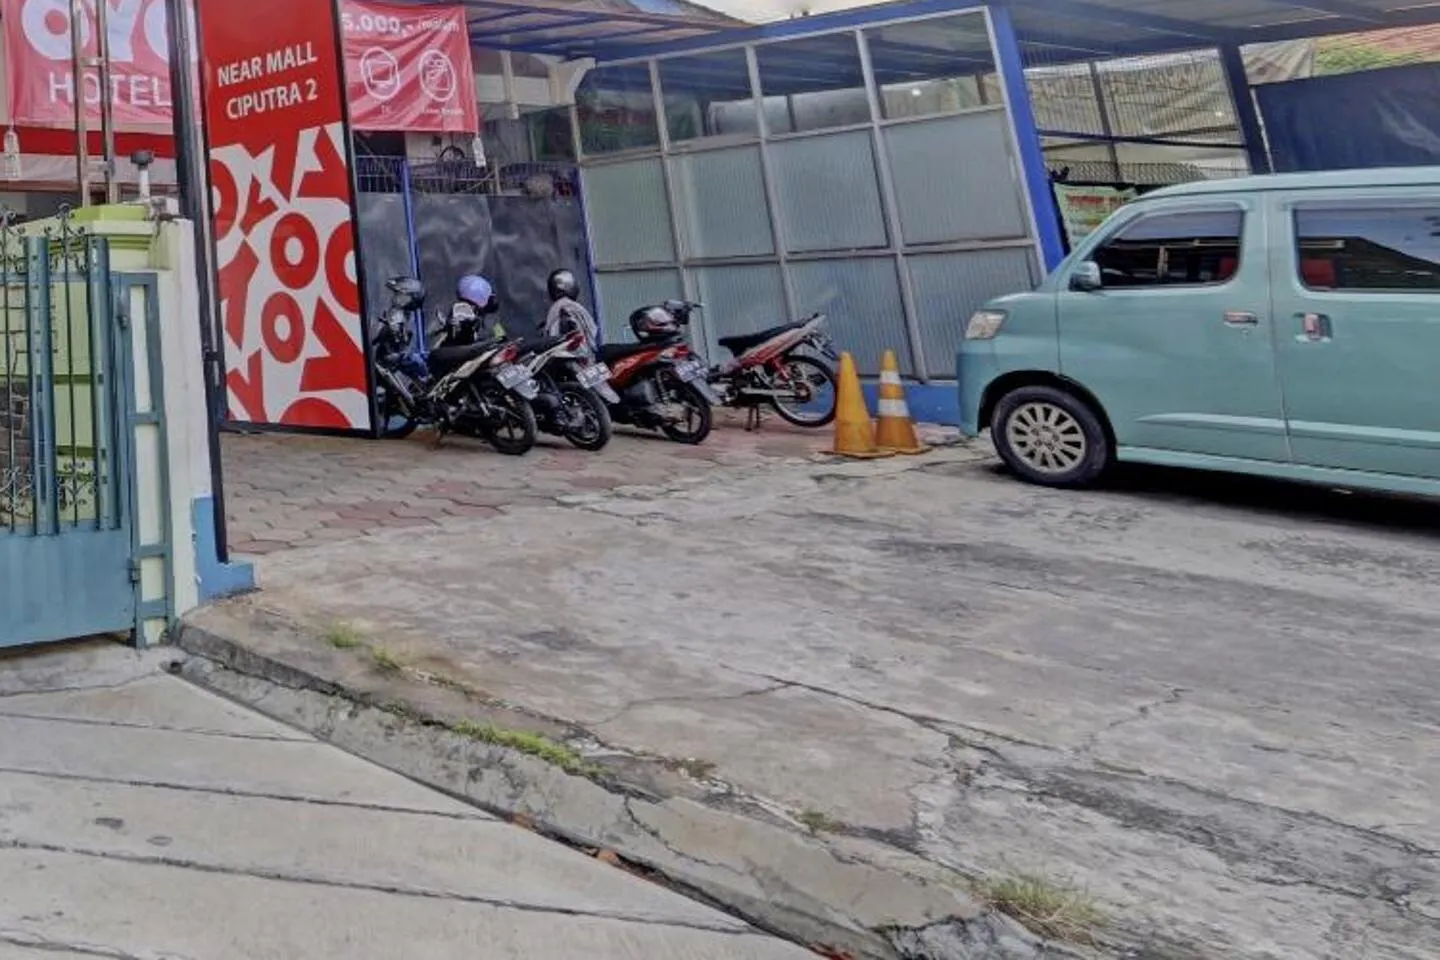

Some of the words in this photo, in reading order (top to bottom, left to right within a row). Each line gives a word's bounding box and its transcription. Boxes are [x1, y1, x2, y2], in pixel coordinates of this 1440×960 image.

[217, 56, 263, 87] NEAR
[266, 41, 318, 74] MALL
[49, 71, 172, 106] HOTEL
[226, 82, 302, 119] CIPUTRA
[305, 78, 318, 100] 2
